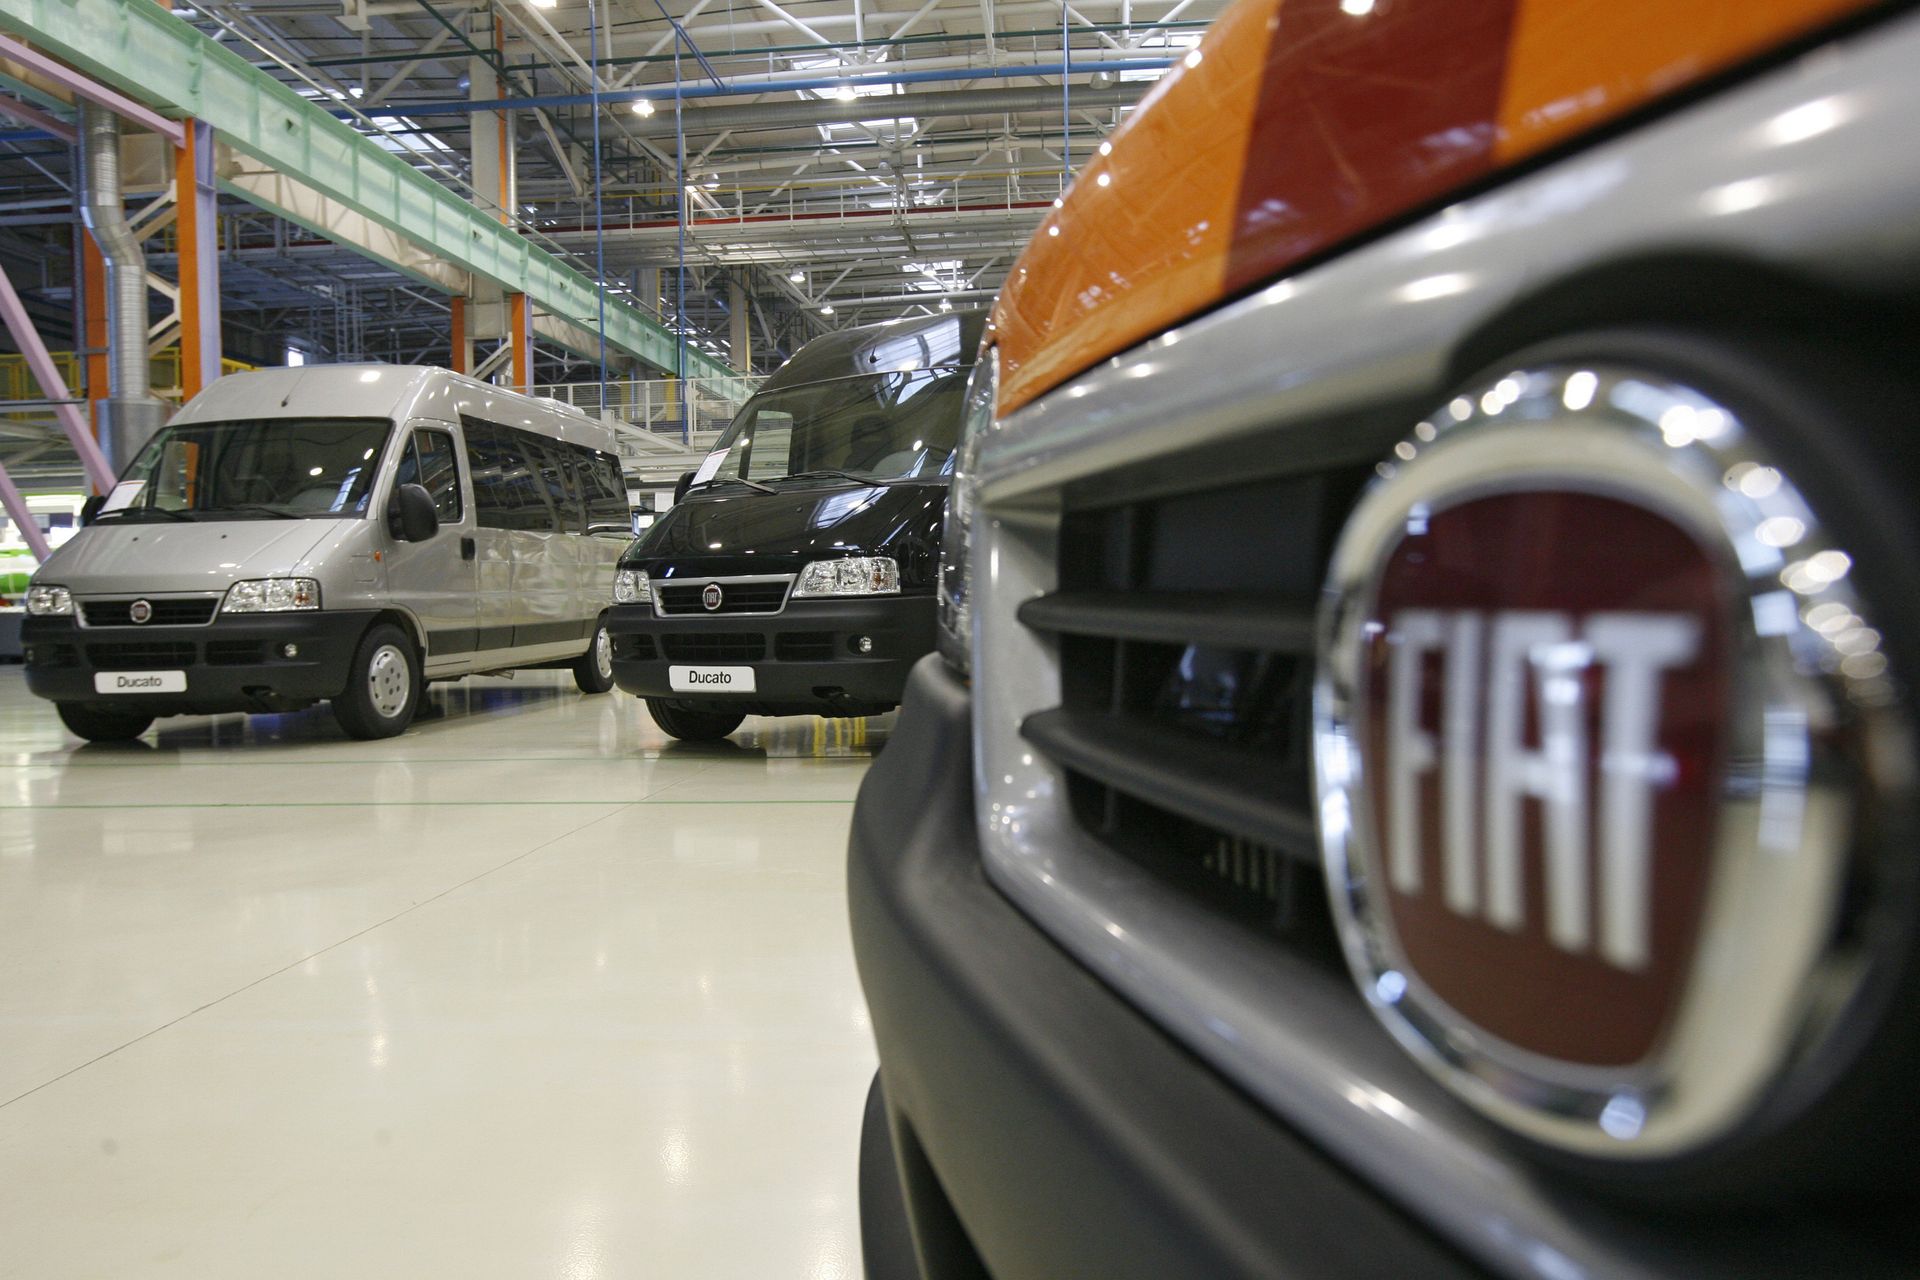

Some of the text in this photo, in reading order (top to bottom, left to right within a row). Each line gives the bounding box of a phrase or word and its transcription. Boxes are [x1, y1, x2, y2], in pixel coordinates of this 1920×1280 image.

[117, 676, 162, 687] Ducato
[689, 671, 731, 683] Ducato
[1386, 609, 1699, 972] FIAT
